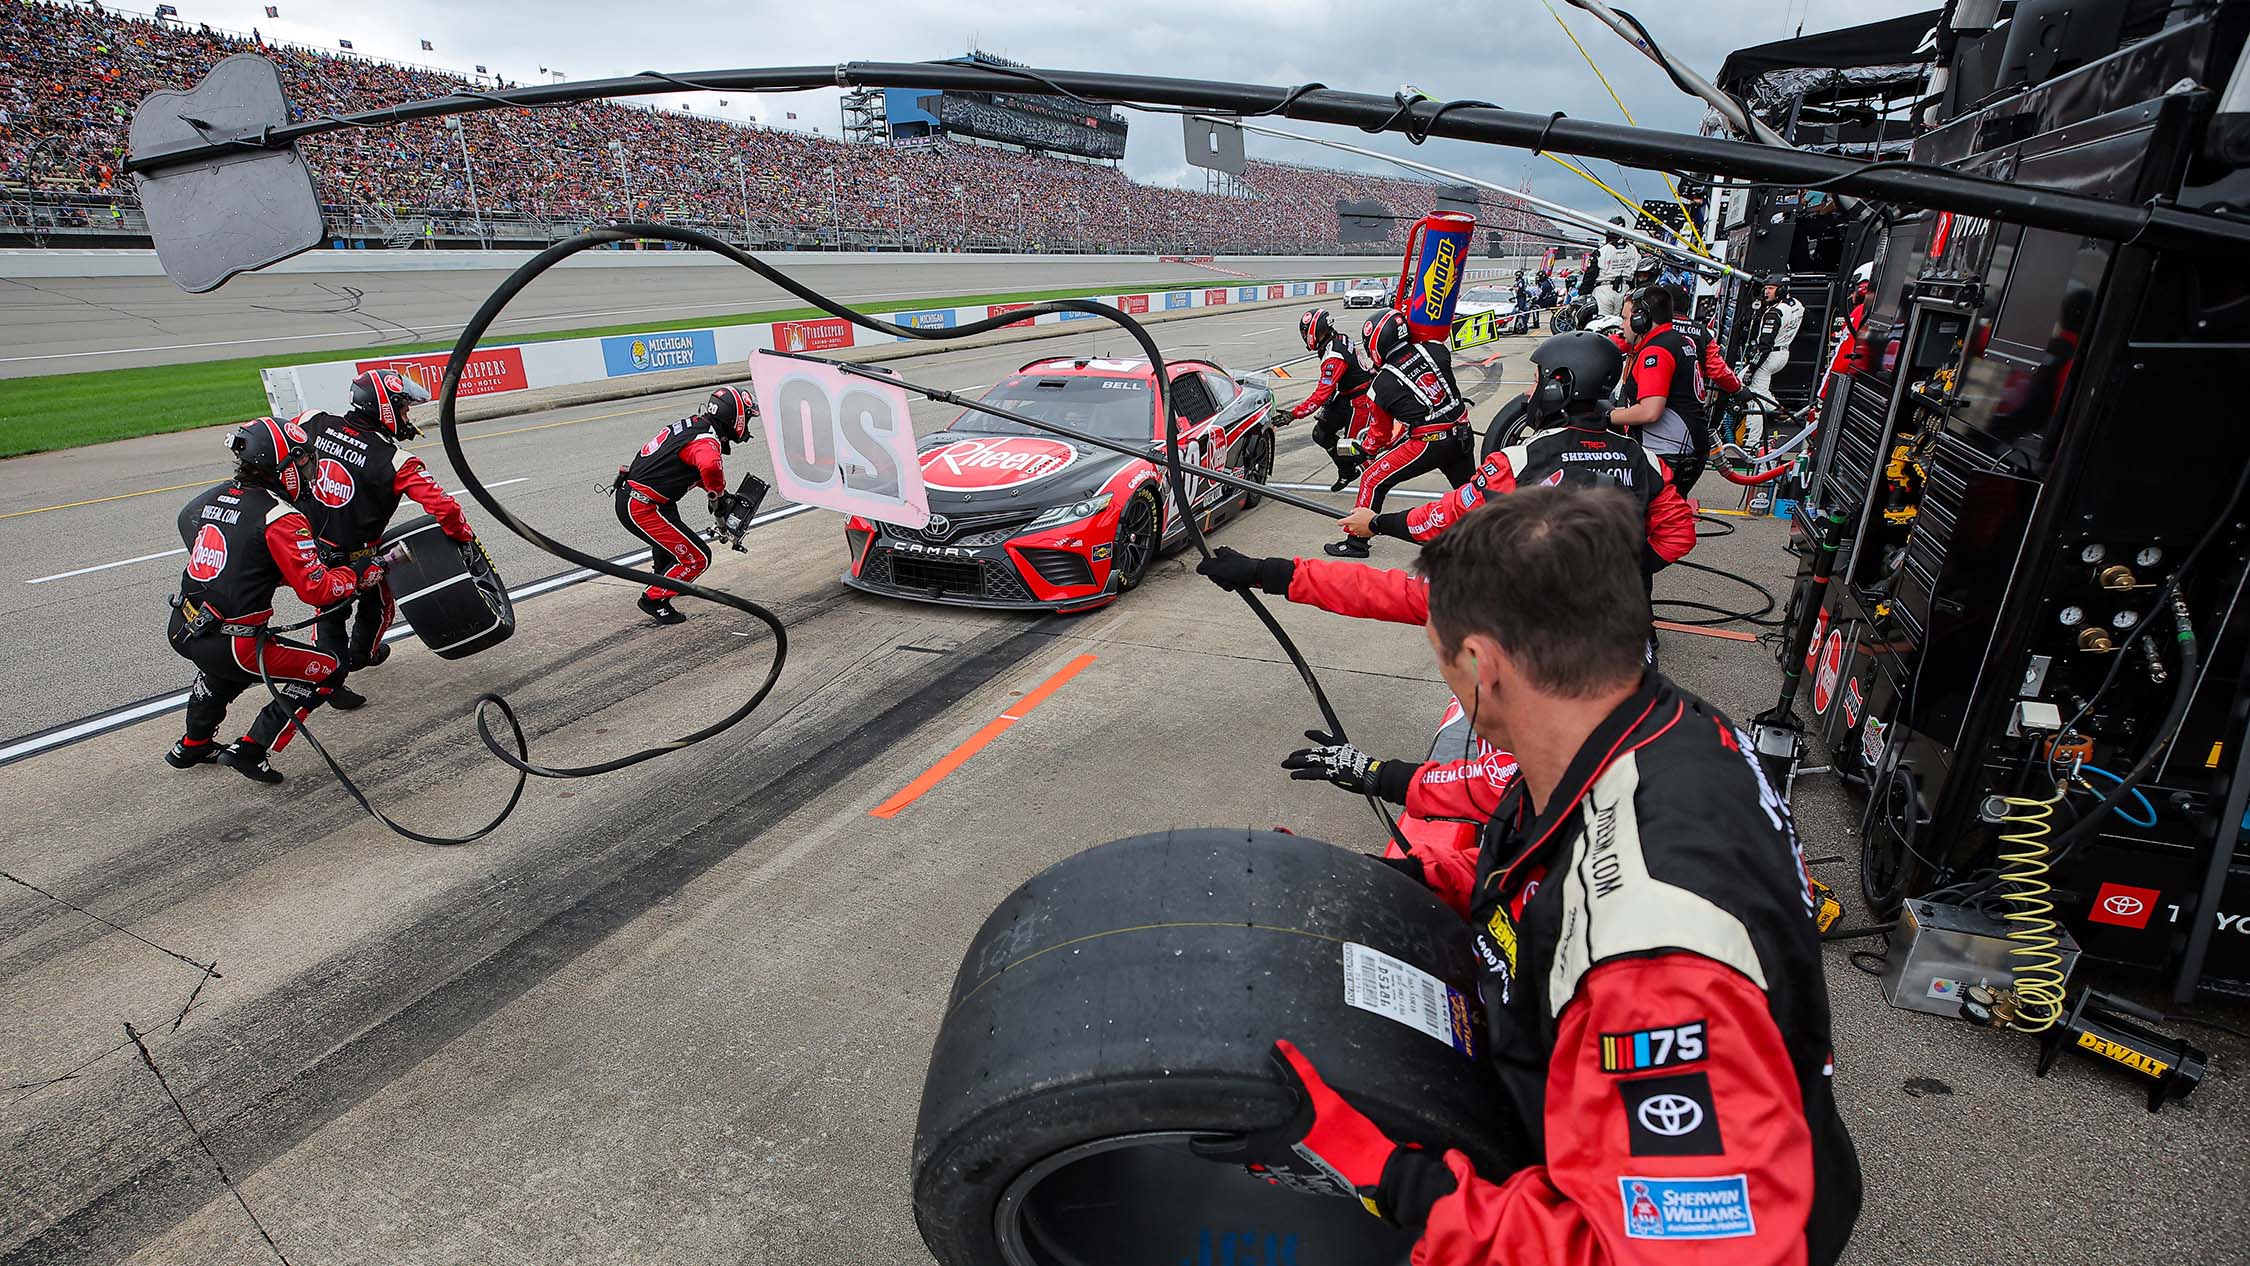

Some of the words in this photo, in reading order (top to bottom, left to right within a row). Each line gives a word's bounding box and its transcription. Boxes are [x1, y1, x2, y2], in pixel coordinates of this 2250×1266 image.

[1427, 240, 1454, 318] SUNOCO
[919, 313, 944, 324] MICHIGAN
[806, 325, 844, 339] FIREKEEPERS
[1397, 325, 1408, 338] 20
[1456, 316, 1491, 345] 41
[648, 336, 693, 351] MICHIGAN
[650, 350, 695, 365] LOTTERY
[430, 360, 506, 382] FIEEPERS
[1102, 380, 1142, 390] BELL
[381, 402, 394, 424] RHEEM
[708, 402, 718, 415] 20
[223, 432, 236, 448] 20
[324, 427, 369, 451] McBEATH
[1580, 440, 1606, 449] TRD
[314, 435, 367, 468] RHEEM.COM
[922, 432, 1046, 475] Rheem
[1561, 451, 1628, 462] SHERWOOD
[317, 460, 352, 499] Rheem
[200, 505, 241, 524] RHEEM.COM
[191, 527, 225, 572] Rheem
[894, 541, 980, 557] CAMRY
[1420, 764, 1483, 784] RHEEM.COM
[1486, 757, 1519, 783] Rheem
[1650, 1023, 1704, 1066] 75
[2077, 1031, 2169, 1079] DEWALT
[1662, 1189, 1739, 1206] SHERWIN
